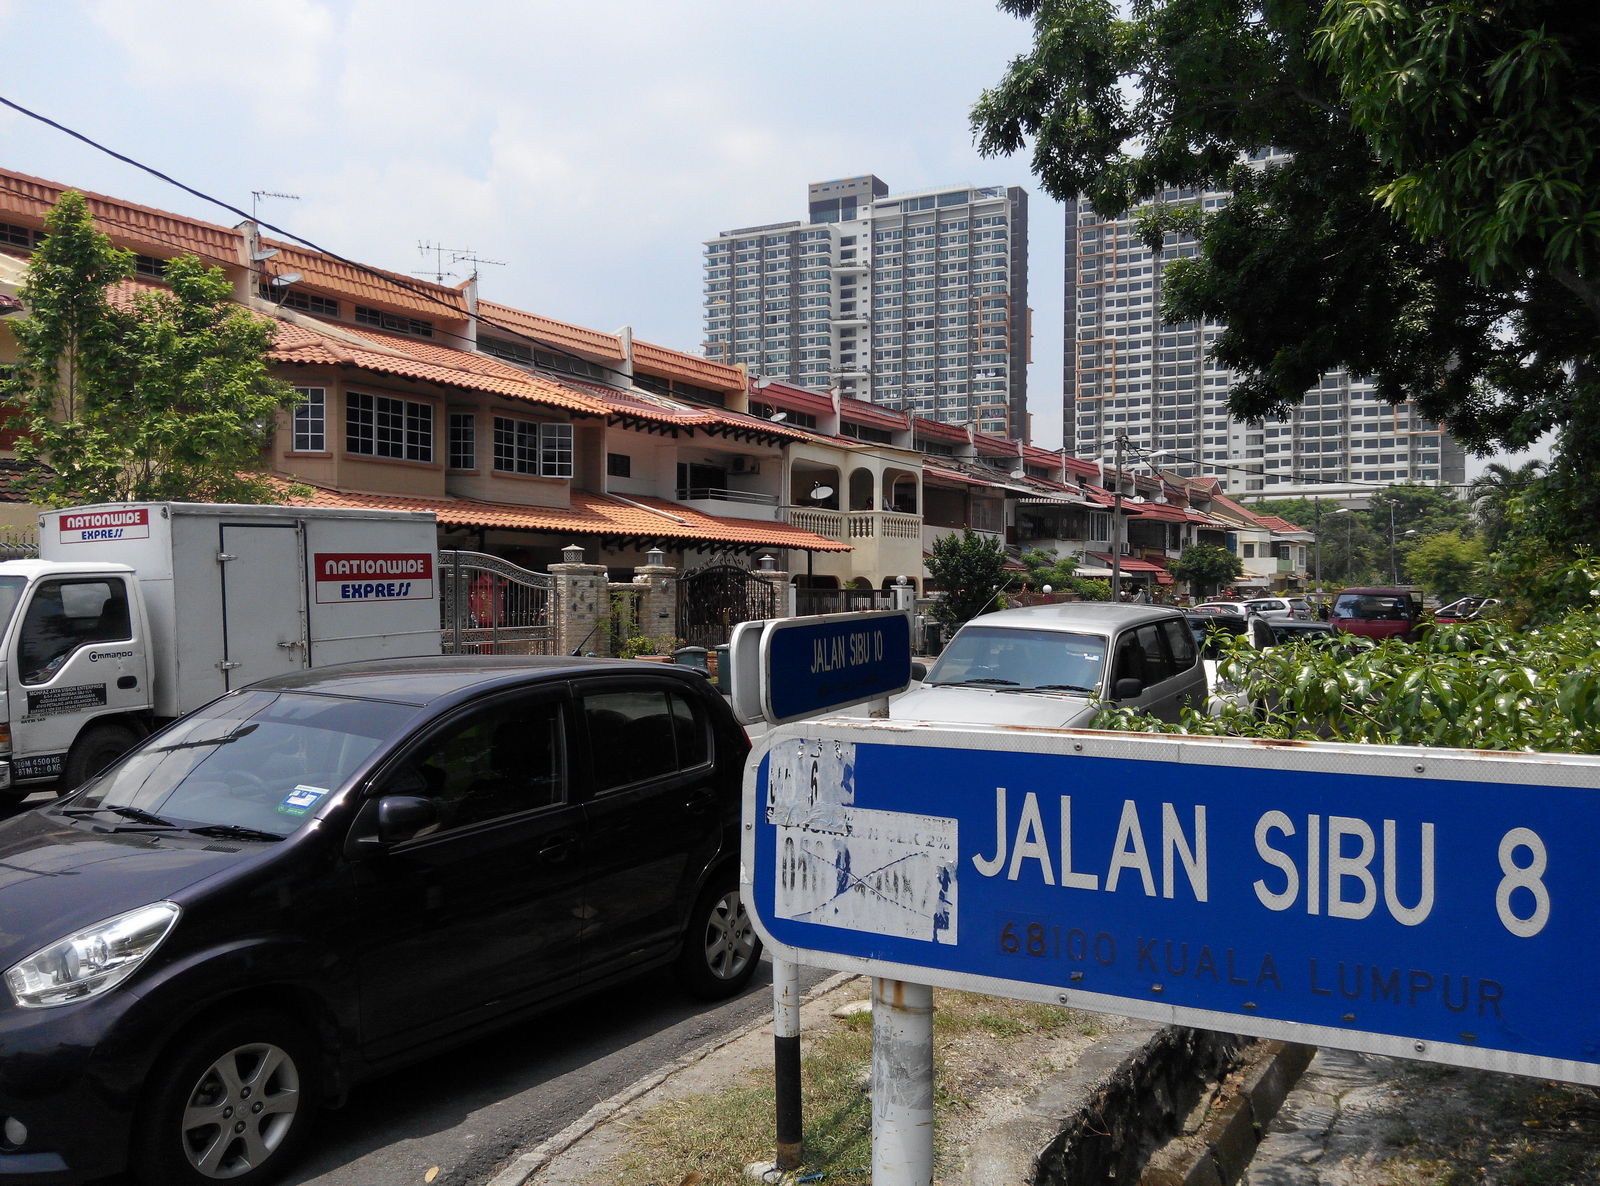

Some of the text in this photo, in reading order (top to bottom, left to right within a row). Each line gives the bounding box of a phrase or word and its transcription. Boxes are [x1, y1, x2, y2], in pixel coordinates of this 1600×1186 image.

[66, 512, 141, 528] NATIONWIDE
[81, 528, 124, 540] EXPRESS
[325, 559, 424, 575] NATIONWIDE
[341, 582, 411, 599] EXPRESS
[811, 630, 883, 674] JALAN SIBU 10
[32, 757, 51, 766] 4500
[971, 787, 1208, 903] JALAN
[1253, 810, 1435, 927] SIBU
[1495, 827, 1550, 938] 8
[1001, 922, 1504, 1019] 68100 KUALA LUMPUR
